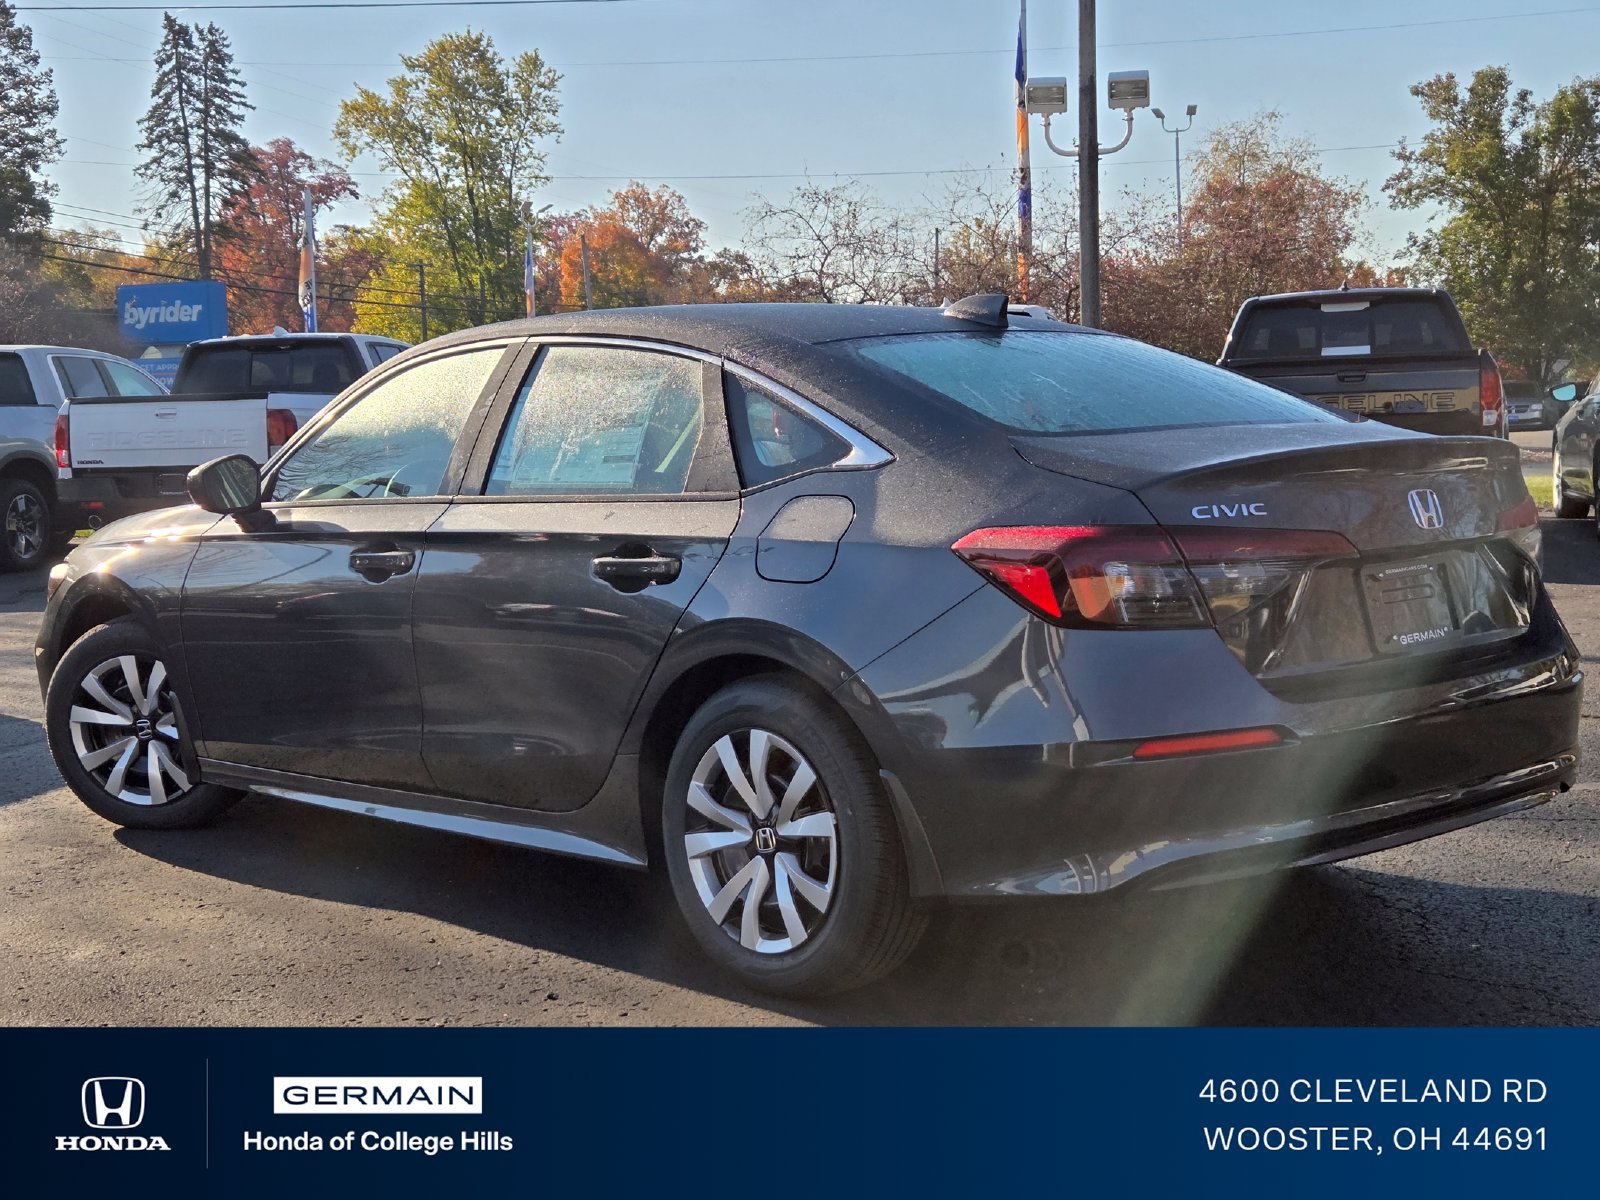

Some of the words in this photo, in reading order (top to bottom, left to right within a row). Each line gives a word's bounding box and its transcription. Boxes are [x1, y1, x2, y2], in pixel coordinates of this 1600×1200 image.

[124, 300, 202, 329] byrider
[157, 363, 180, 371] APPR
[1191, 502, 1267, 519] CIVIC
[1399, 628, 1445, 645] GERMAIN
